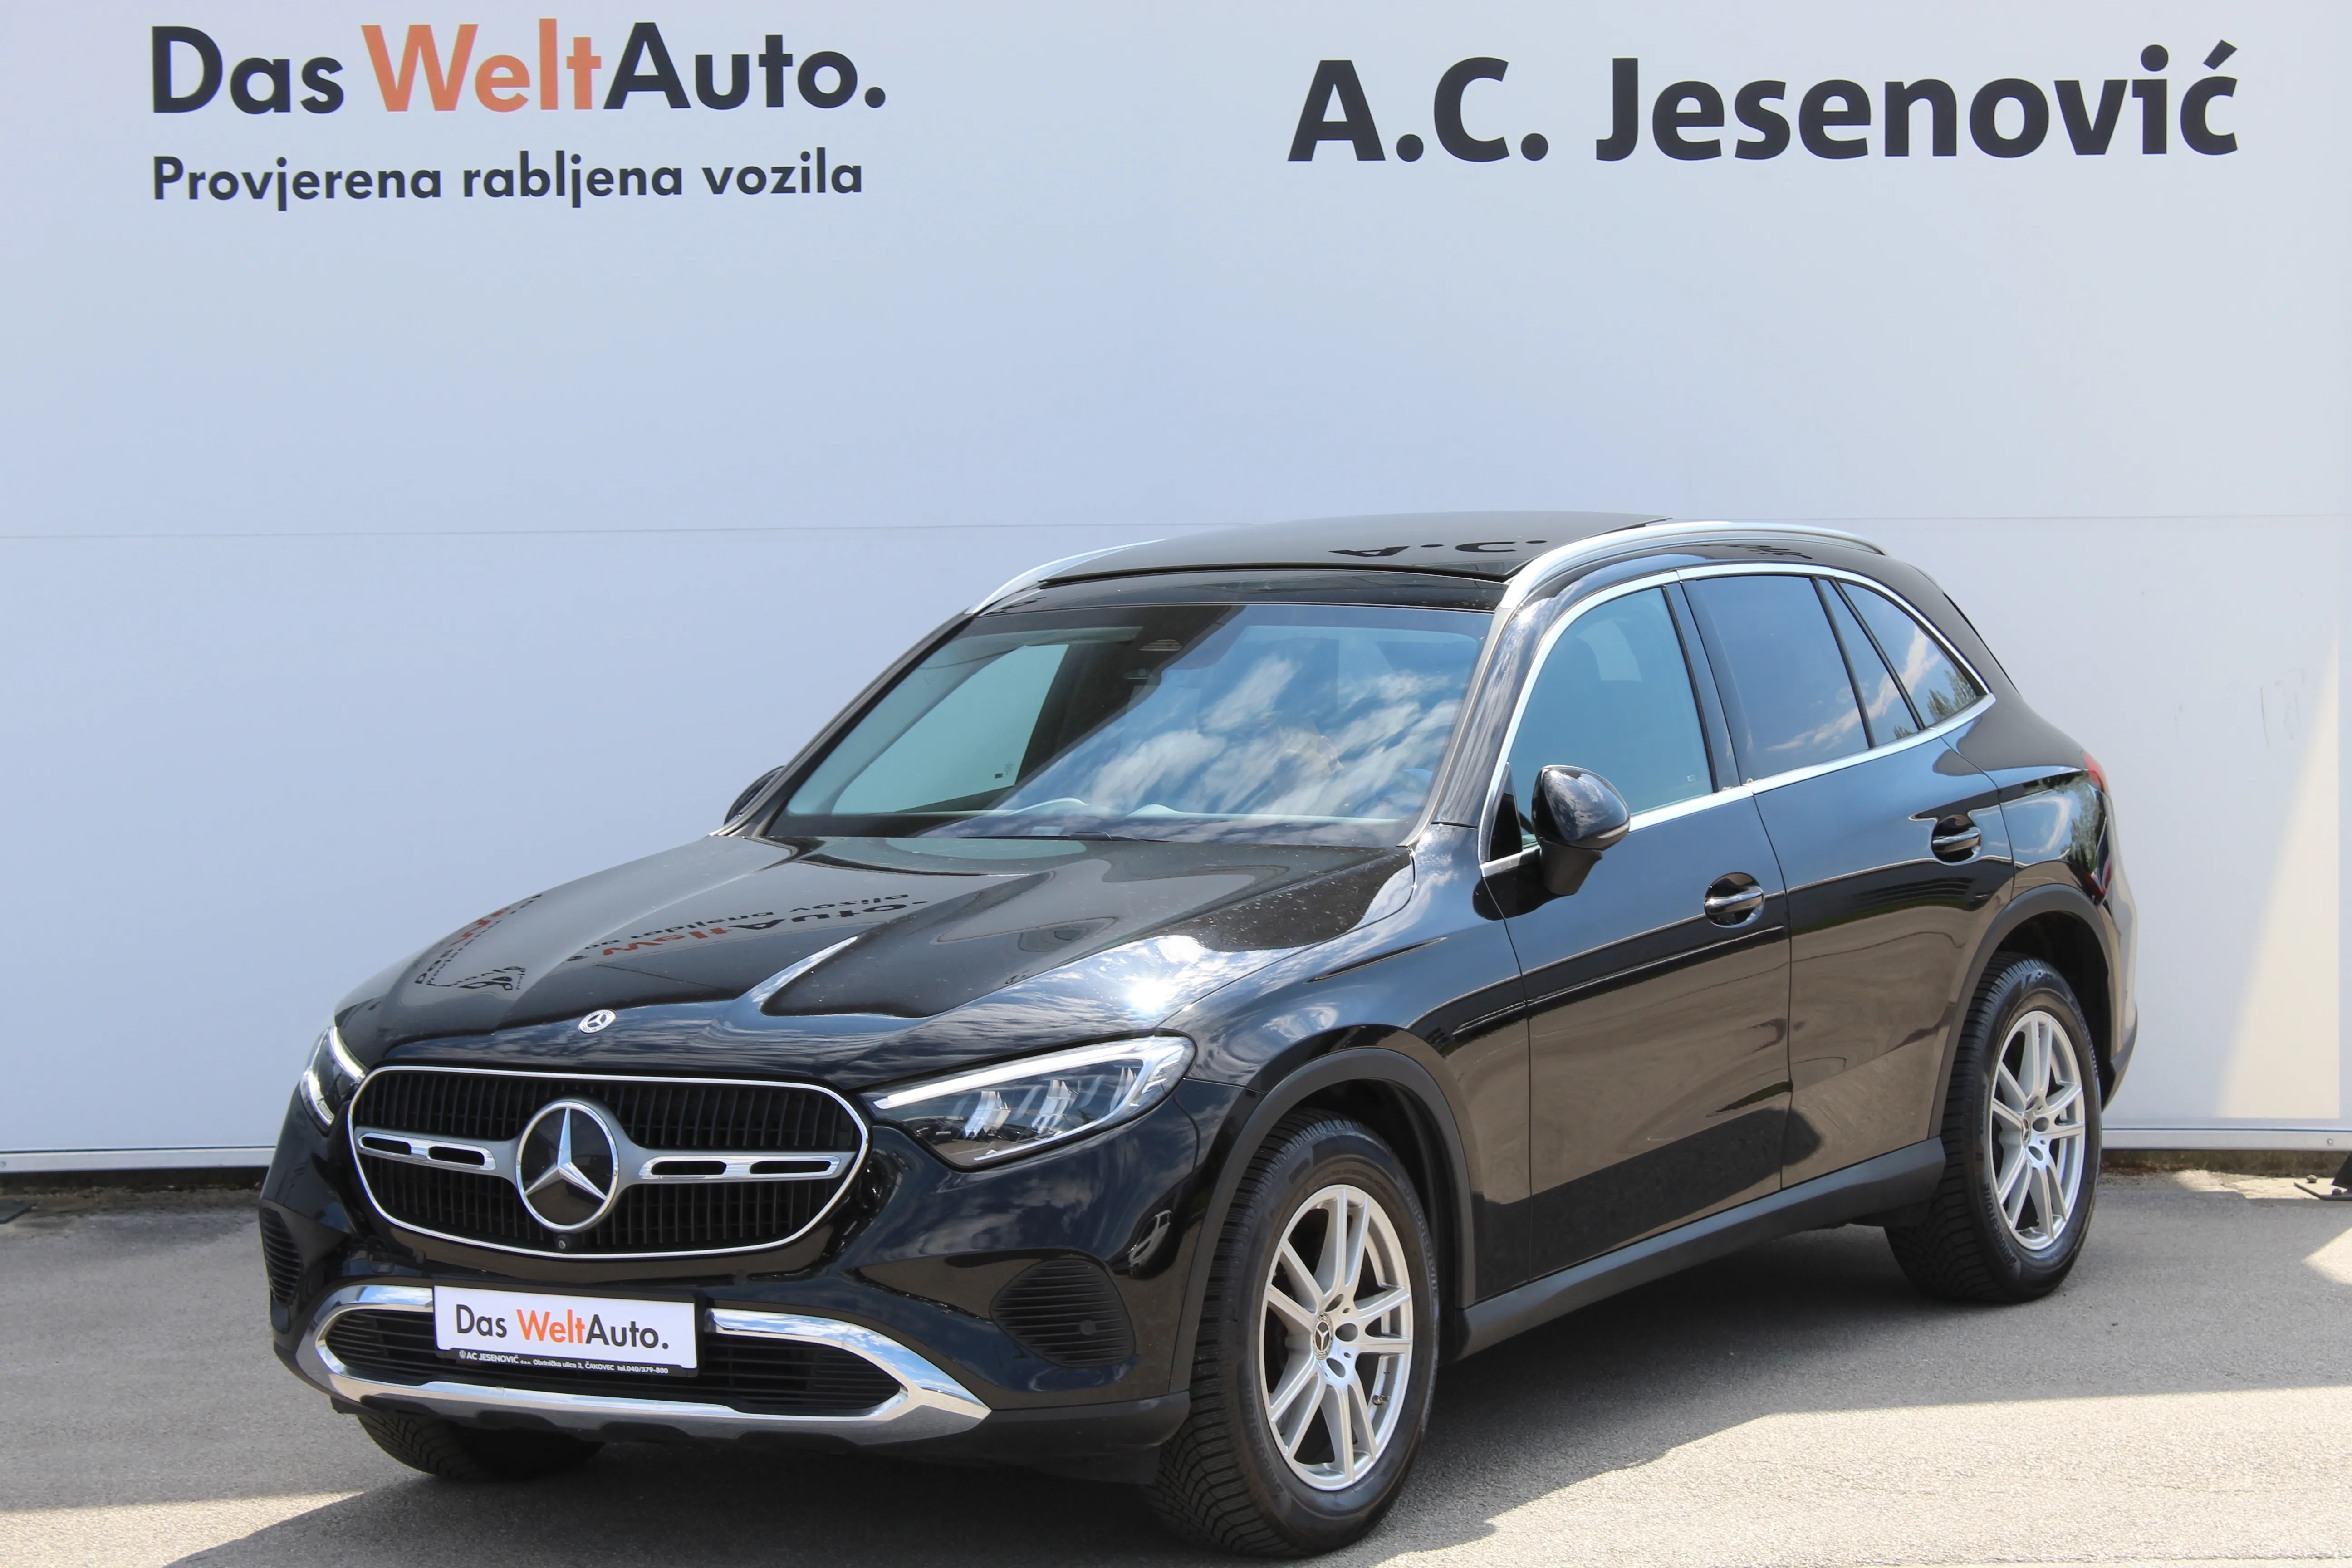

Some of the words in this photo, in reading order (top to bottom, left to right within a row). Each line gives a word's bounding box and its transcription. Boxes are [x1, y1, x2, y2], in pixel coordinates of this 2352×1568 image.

[152, 26, 344, 114] Das
[362, 19, 886, 113] WeltAuto.
[1288, 57, 1548, 162] A.C.
[1596, 40, 2238, 161] Jesenović
[154, 156, 441, 211] Provjerena
[464, 150, 682, 208] rabljena
[702, 147, 862, 195] vozila
[1982, 1182, 2017, 1269] BRIDGESTONE
[456, 1304, 507, 1338] Das
[516, 1309, 669, 1349] WeltAuto.
[466, 1352, 477, 1360] AC
[479, 1353, 519, 1364] JESENOVIĆ
[585, 1361, 614, 1371] ČAKOVEC
